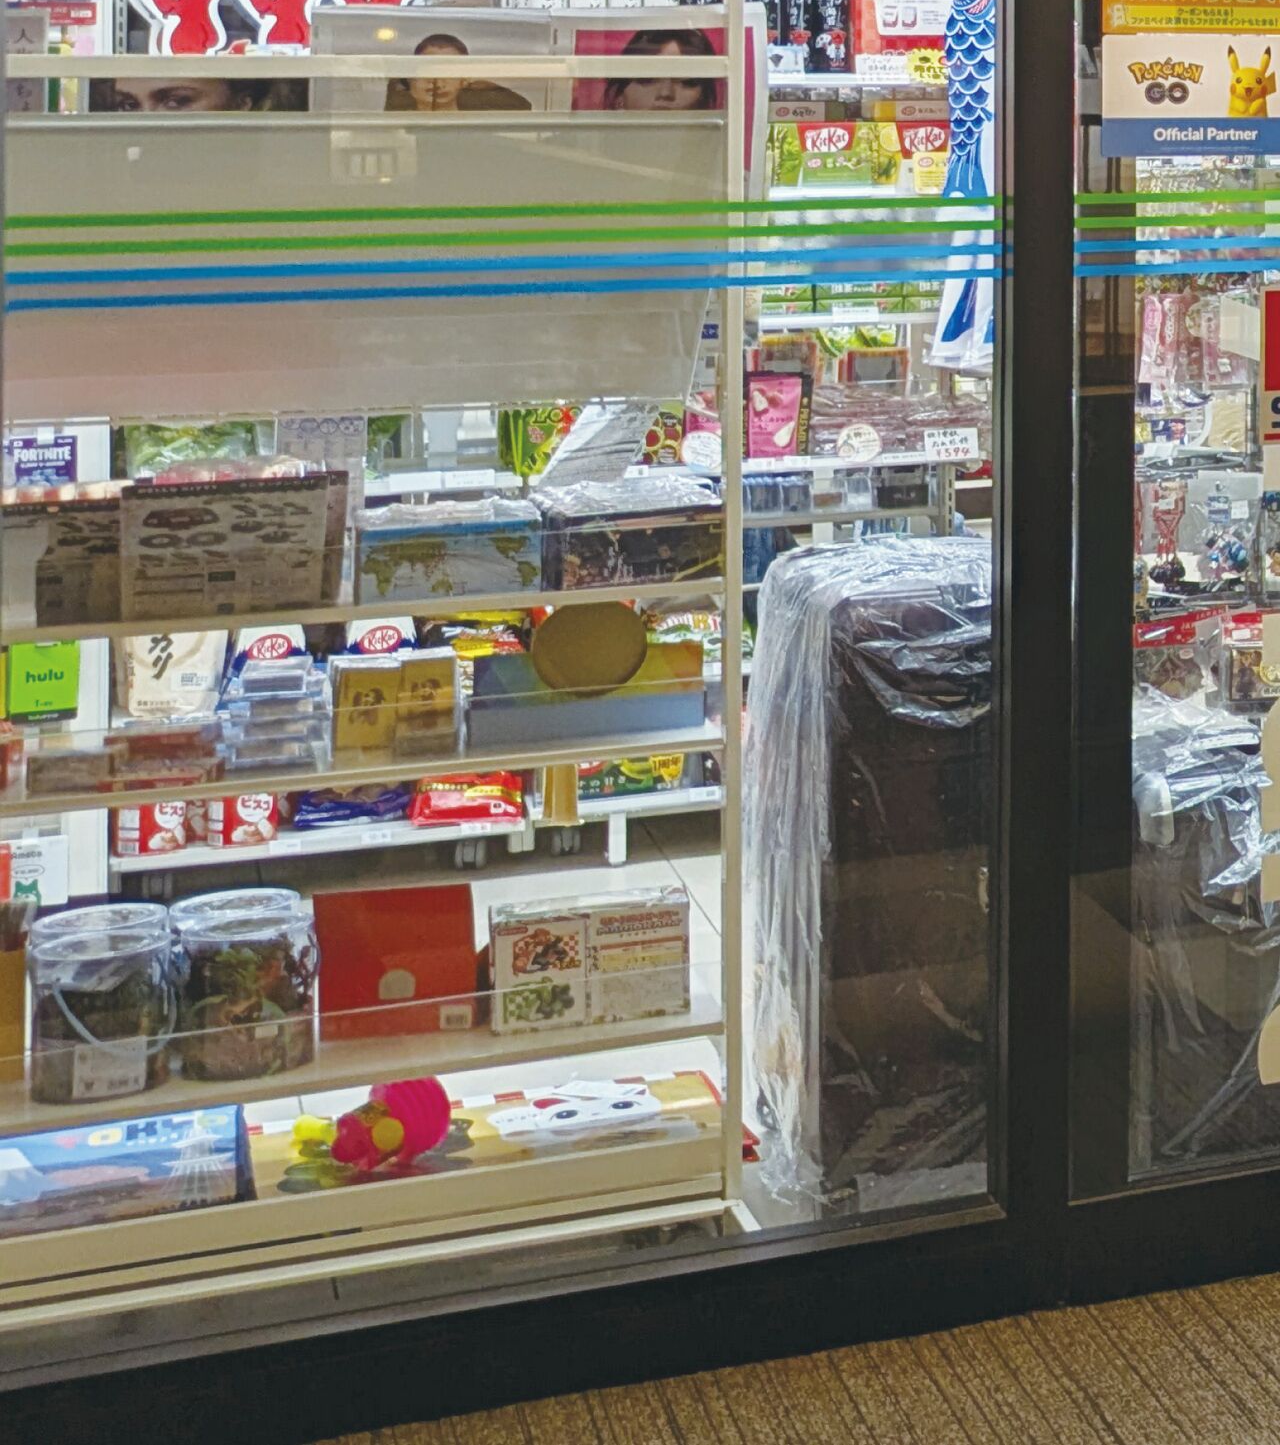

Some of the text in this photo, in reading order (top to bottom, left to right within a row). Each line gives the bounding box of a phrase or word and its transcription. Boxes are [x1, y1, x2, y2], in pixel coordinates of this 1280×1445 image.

[1144, 81, 1190, 105] GO
[811, 129, 847, 153] KitKat
[909, 128, 944, 153] KitKat
[1153, 127, 1258, 141] Official Partner
[14, 446, 72, 463] FORTNITE
[256, 637, 287, 659] KitKat
[367, 628, 399, 653] KitKat
[25, 668, 65, 684] hulu
[241, 794, 271, 811] ビスコ
